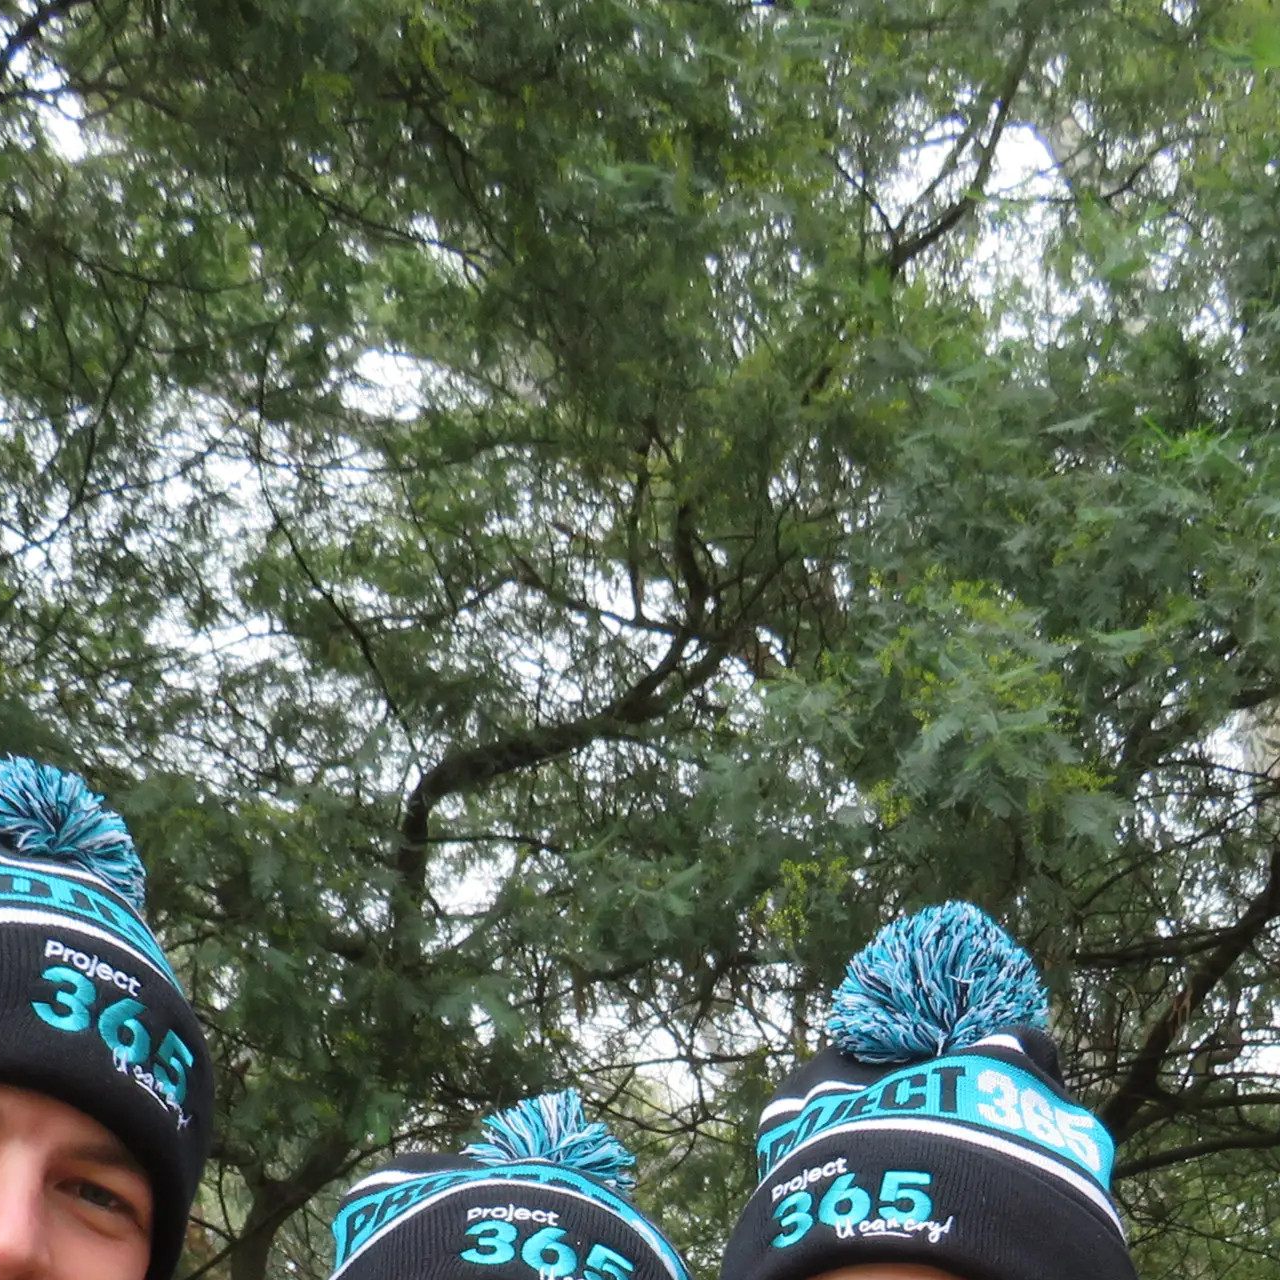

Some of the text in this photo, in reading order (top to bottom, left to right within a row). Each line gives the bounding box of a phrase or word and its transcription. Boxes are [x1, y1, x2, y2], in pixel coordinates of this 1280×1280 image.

[44, 940, 141, 996] project
[31, 965, 193, 1104] 365
[978, 1069, 1100, 1171] 365
[771, 1157, 847, 1202] project
[467, 1203, 559, 1226] project
[772, 1171, 932, 1248] 365
[859, 1218, 900, 1233] can
